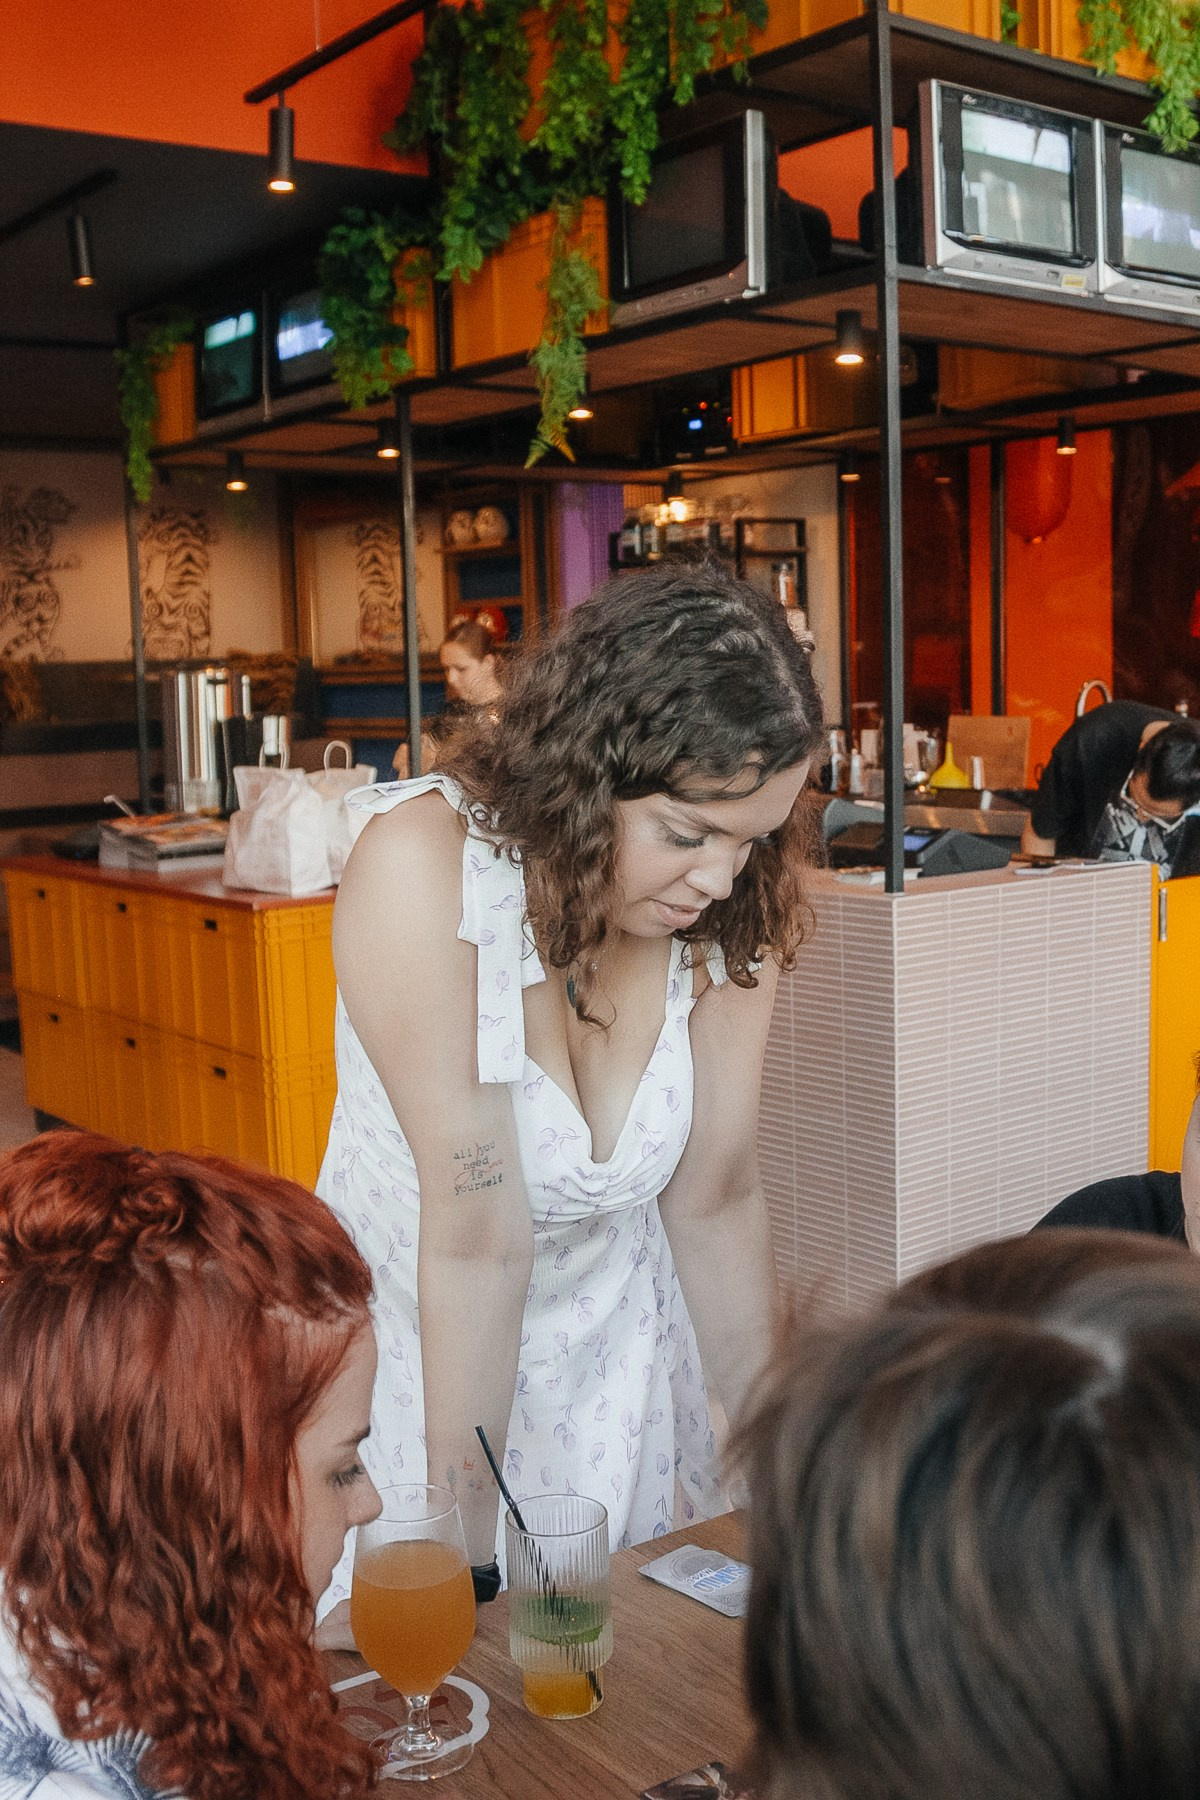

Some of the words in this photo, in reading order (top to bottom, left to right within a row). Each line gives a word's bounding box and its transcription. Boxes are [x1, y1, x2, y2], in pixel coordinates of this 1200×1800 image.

[453, 1148, 472, 1160] all
[479, 1141, 496, 1156] you
[463, 1156, 489, 1170] need
[454, 1173, 502, 1196] yourself
